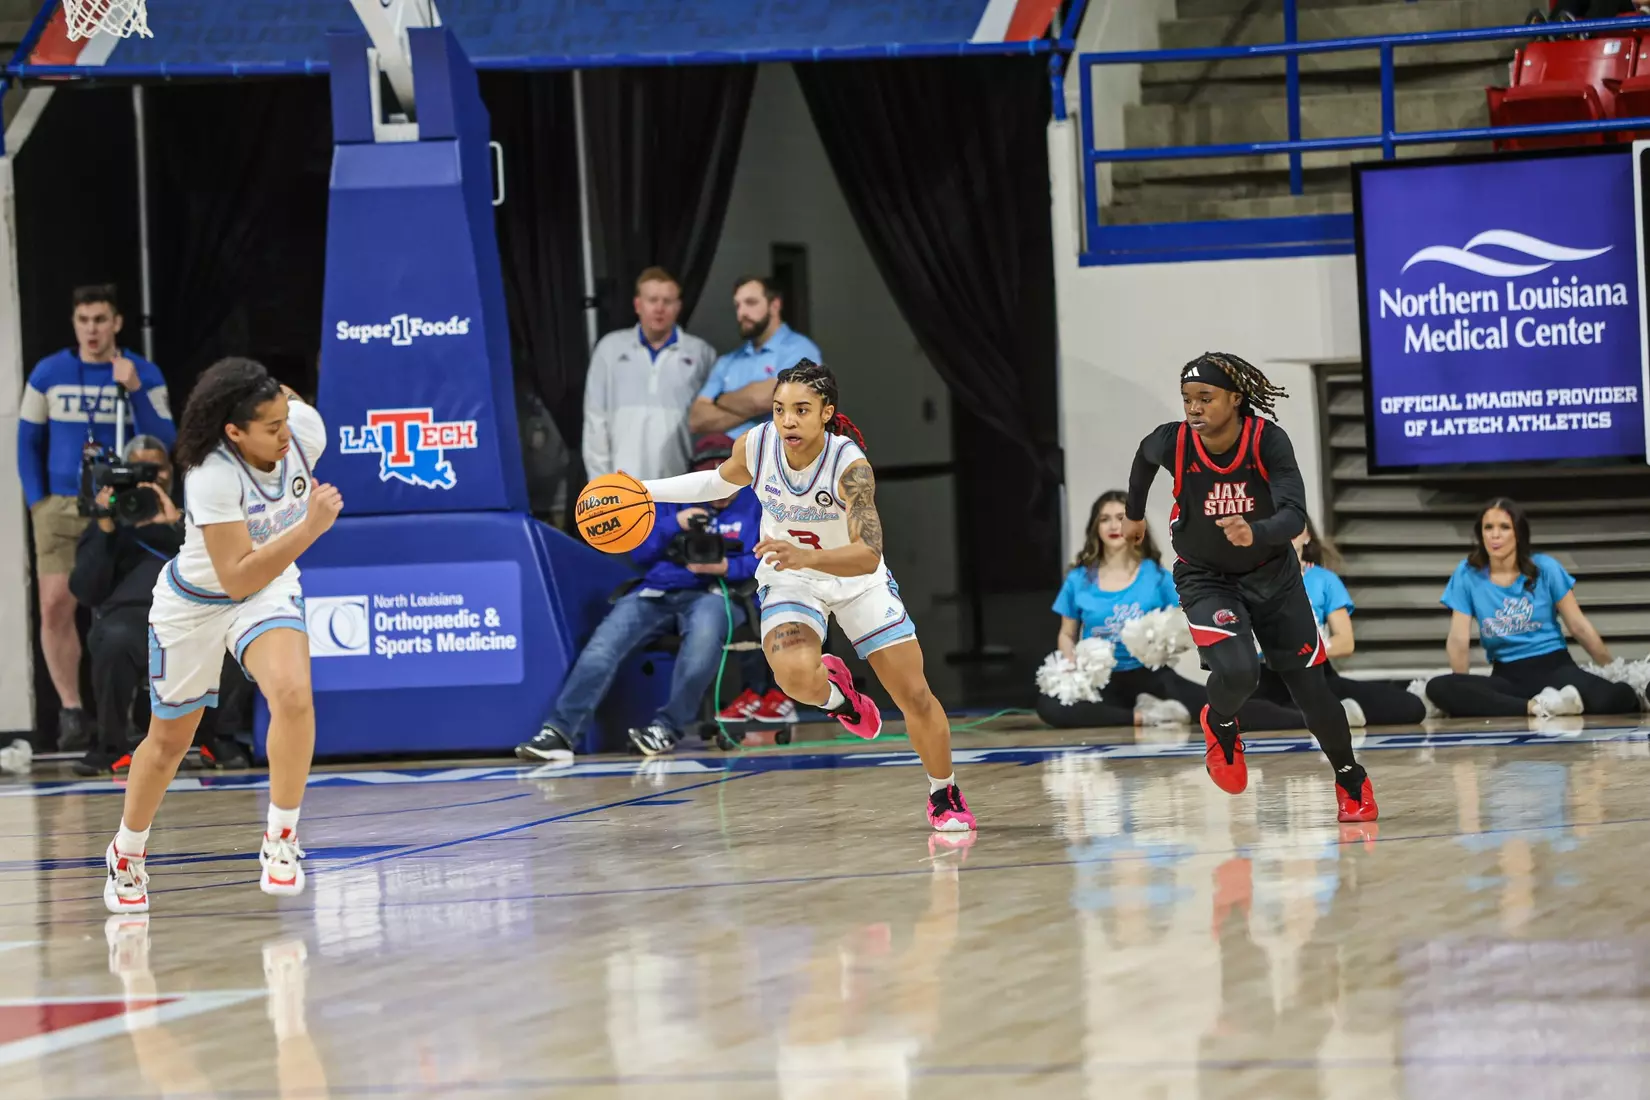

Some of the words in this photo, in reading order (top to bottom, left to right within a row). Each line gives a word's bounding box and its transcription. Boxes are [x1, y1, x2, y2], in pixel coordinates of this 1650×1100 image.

[1379, 282, 1499, 318] Northern
[1506, 275, 1628, 311] Louisiana
[336, 320, 393, 343] Super
[409, 315, 469, 337] Foods
[1404, 316, 1508, 354] Medical
[1514, 316, 1606, 347] Center
[1380, 393, 1463, 414] OFFICIAL
[1465, 389, 1543, 410] IMAGING
[1546, 386, 1638, 406] PROVIDER
[1404, 419, 1428, 437] OF
[1430, 416, 1503, 436] LATECH
[1506, 412, 1612, 433] ATHLETICS
[1207, 482, 1248, 500] JAX
[577, 495, 620, 516] Wilson
[1204, 497, 1255, 516] STATE
[585, 515, 622, 538] NCAA
[373, 594, 408, 609] North
[410, 593, 464, 608] Louisiana
[374, 609, 480, 635] Orthopaedic
[484, 607, 501, 628] &
[375, 635, 433, 660] Sports
[436, 631, 517, 653] Medicine
